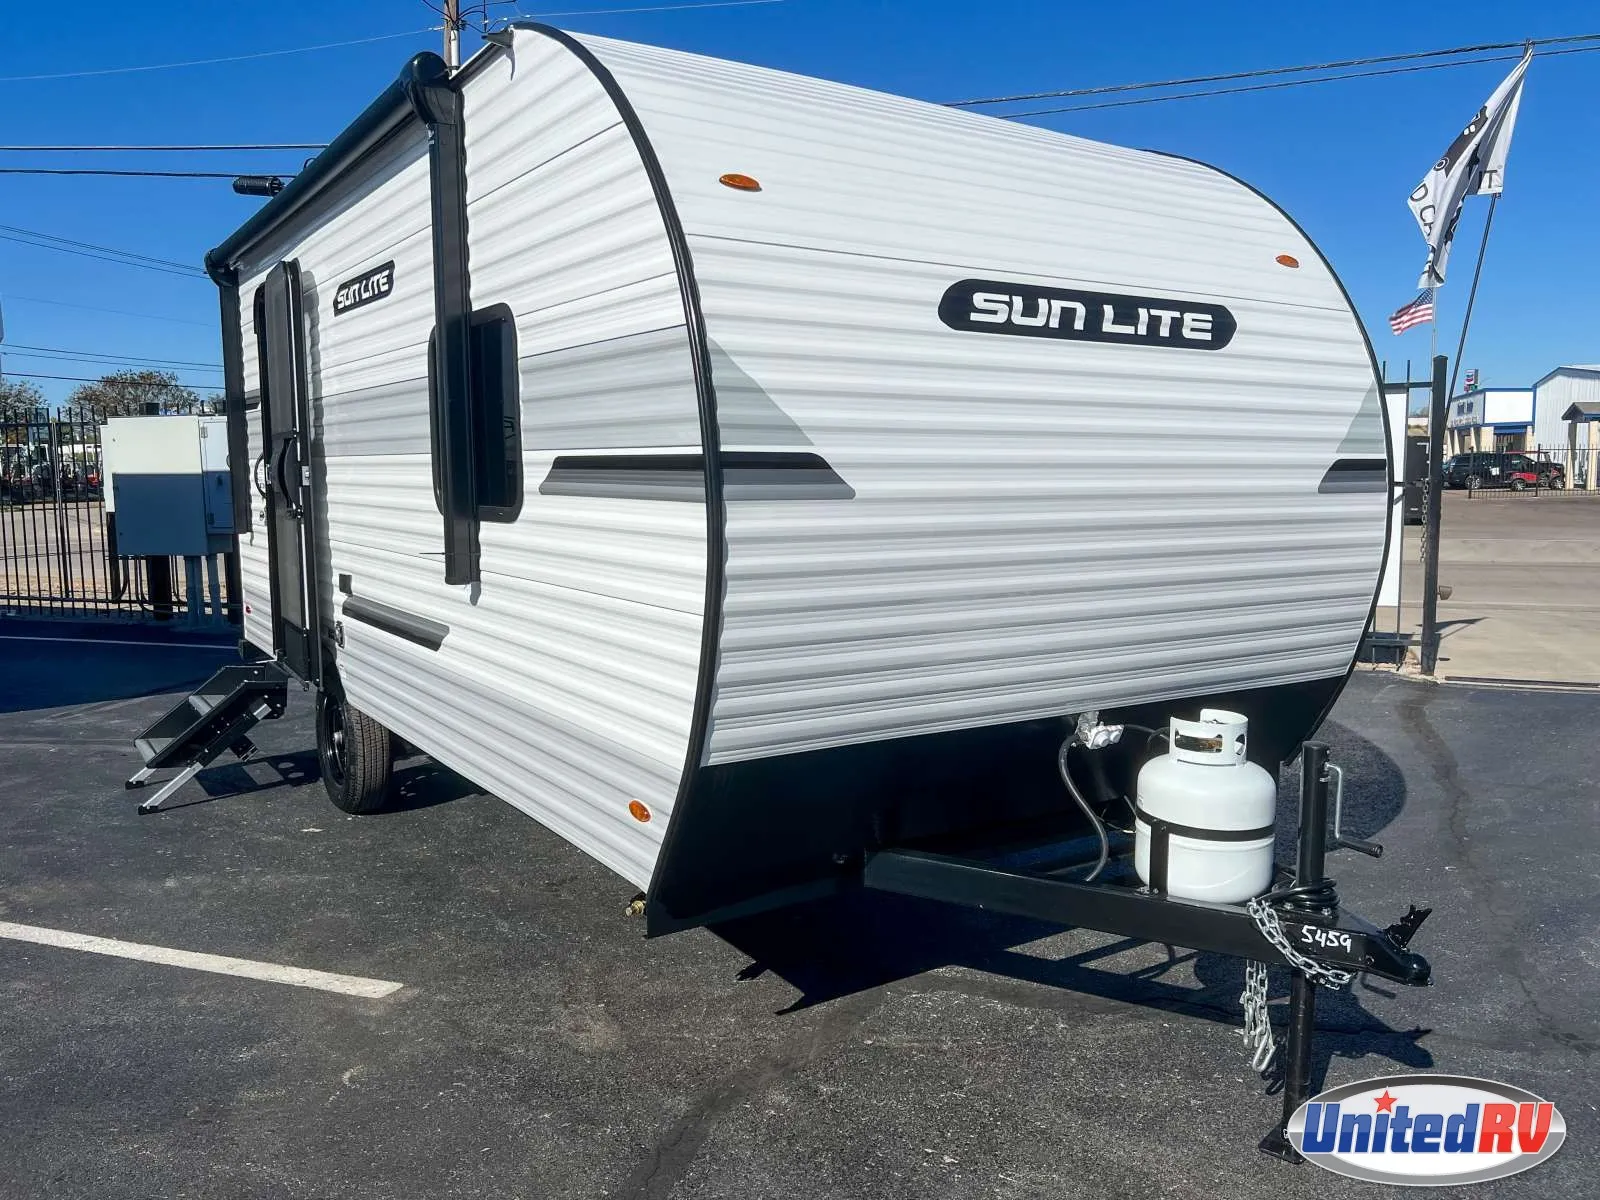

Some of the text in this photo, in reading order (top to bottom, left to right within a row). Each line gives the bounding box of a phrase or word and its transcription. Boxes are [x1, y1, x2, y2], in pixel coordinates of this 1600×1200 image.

[337, 270, 390, 310] SUN LITE
[969, 291, 1213, 341] SUN LITE
[1301, 924, 1352, 953] 5459
